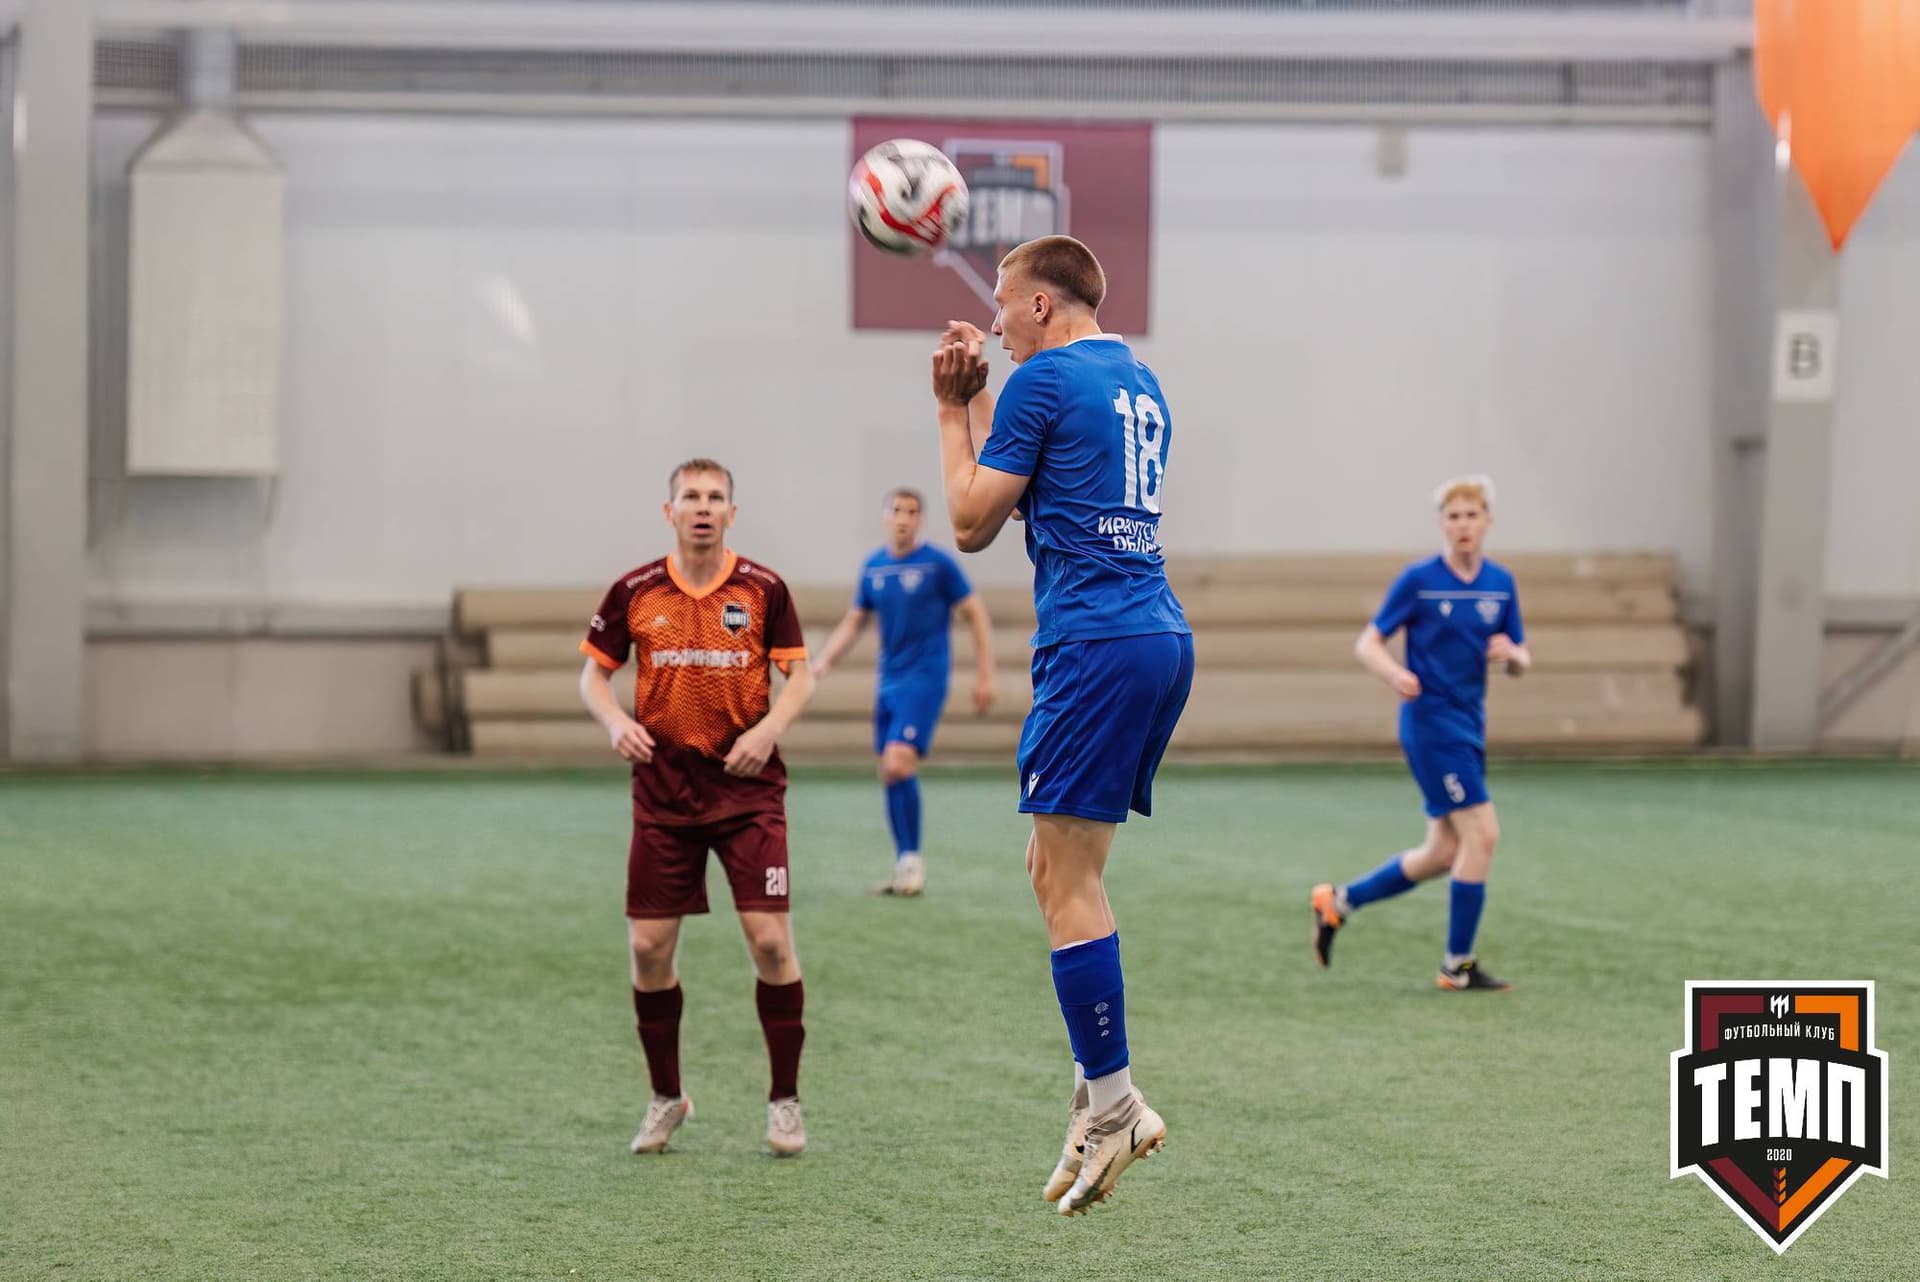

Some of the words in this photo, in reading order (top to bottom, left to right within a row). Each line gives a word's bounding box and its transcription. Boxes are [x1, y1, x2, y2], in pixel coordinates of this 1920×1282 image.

[1113, 388, 1165, 513] 18
[1443, 773, 1466, 803] 5
[765, 866, 788, 896] 20
